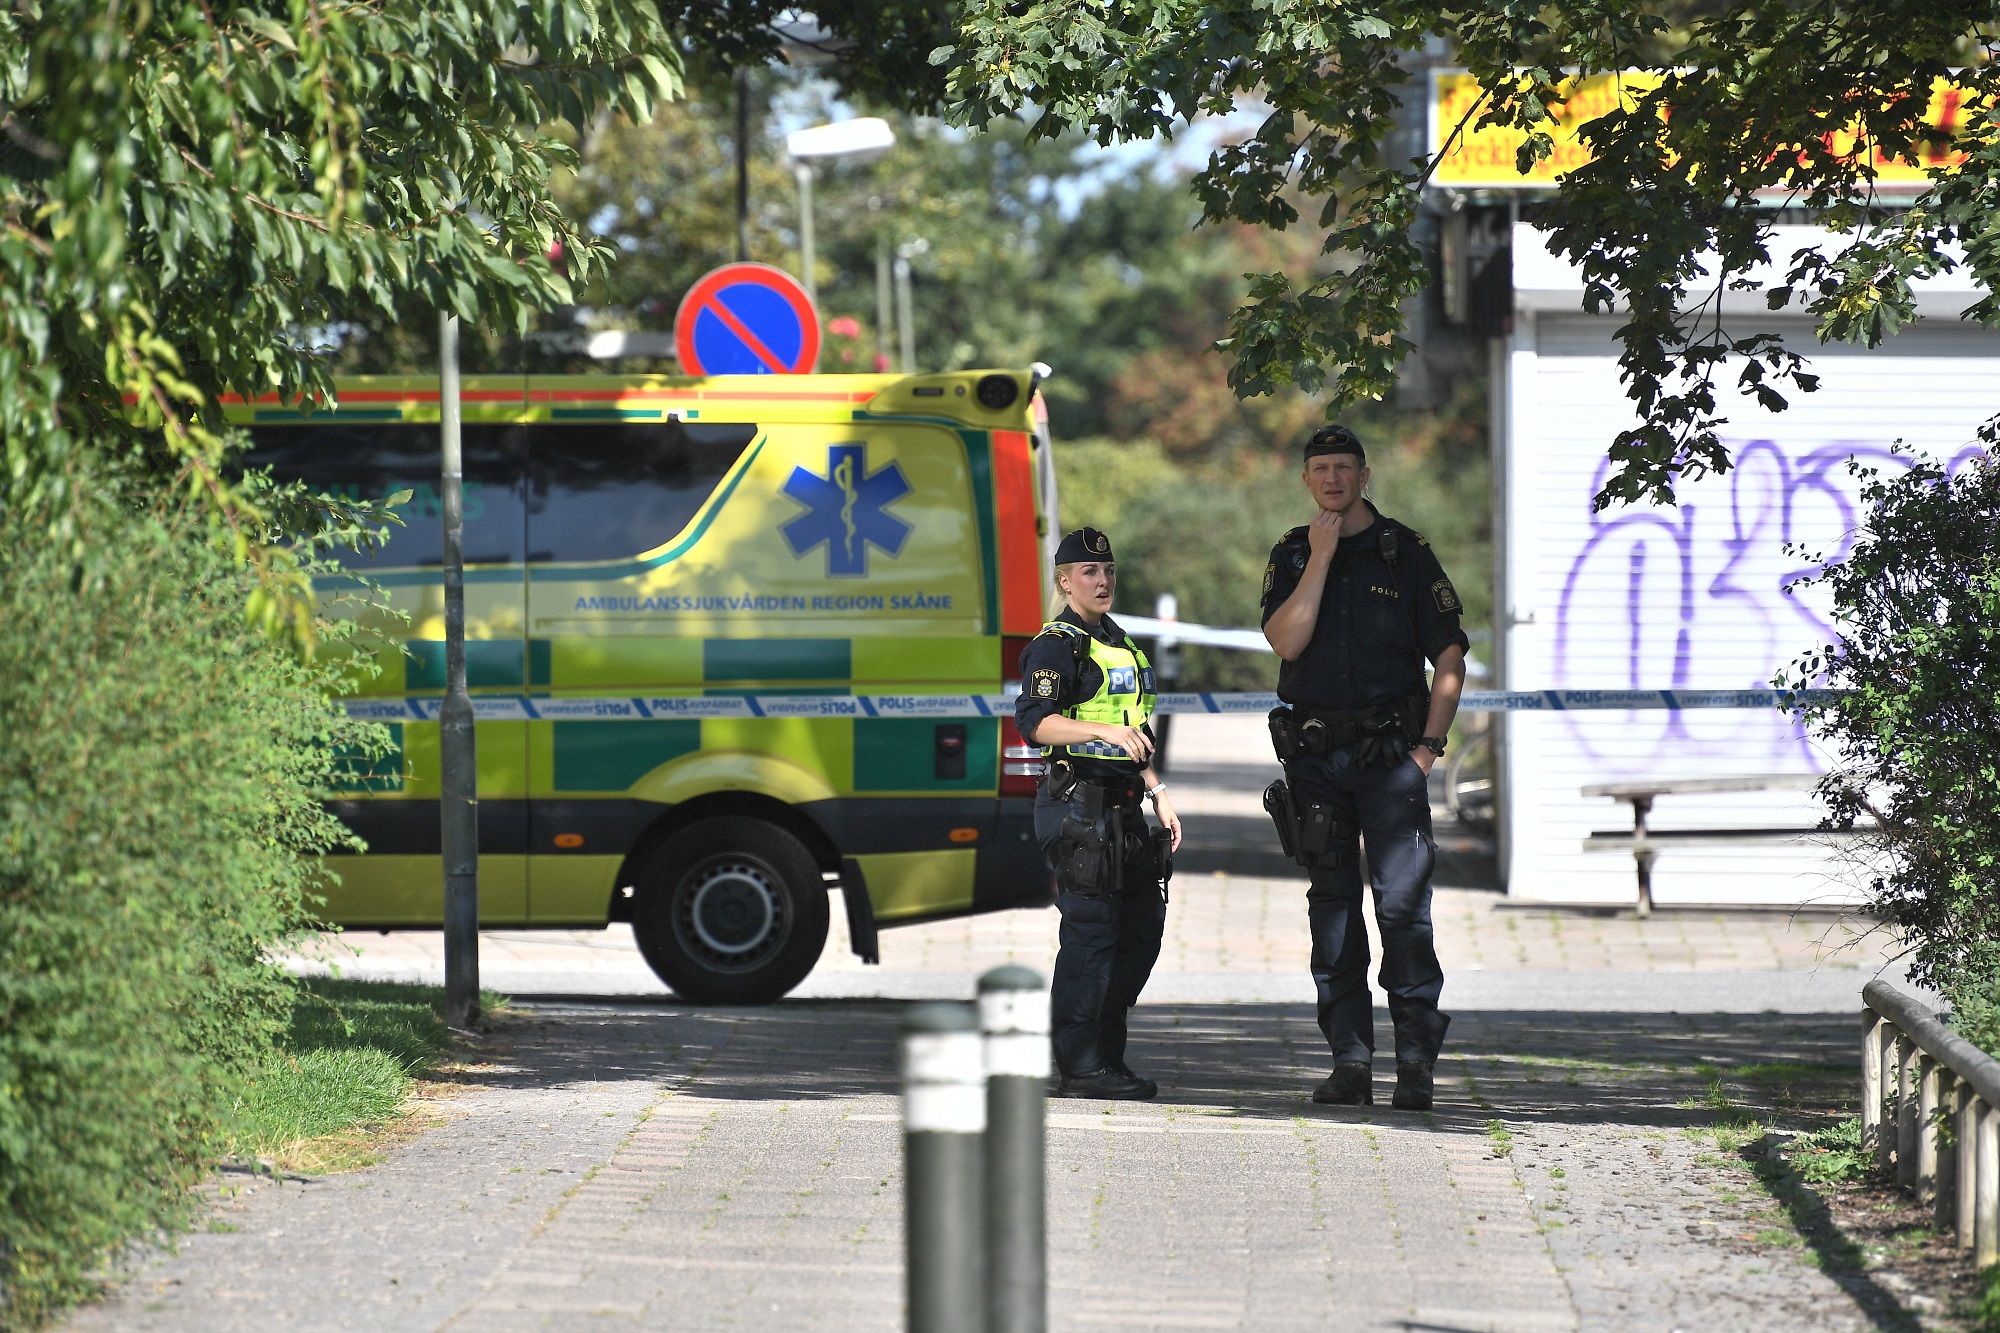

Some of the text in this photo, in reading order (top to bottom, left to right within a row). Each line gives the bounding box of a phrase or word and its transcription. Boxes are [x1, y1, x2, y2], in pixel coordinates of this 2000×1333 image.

[575, 591, 953, 611] AMBULANSSJUKVÅRDEN REGION SKÅNE
[1034, 669, 1059, 680] POLIS
[878, 697, 969, 709] POLIS AVSPÄRRAT
[1506, 697, 1542, 708] POLIS
[1565, 691, 1600, 703] POLIS
[1737, 694, 1773, 706] POLIS
[594, 704, 631, 716] POLIS
[652, 699, 688, 710] POLIS
[820, 703, 856, 715] POLIS
